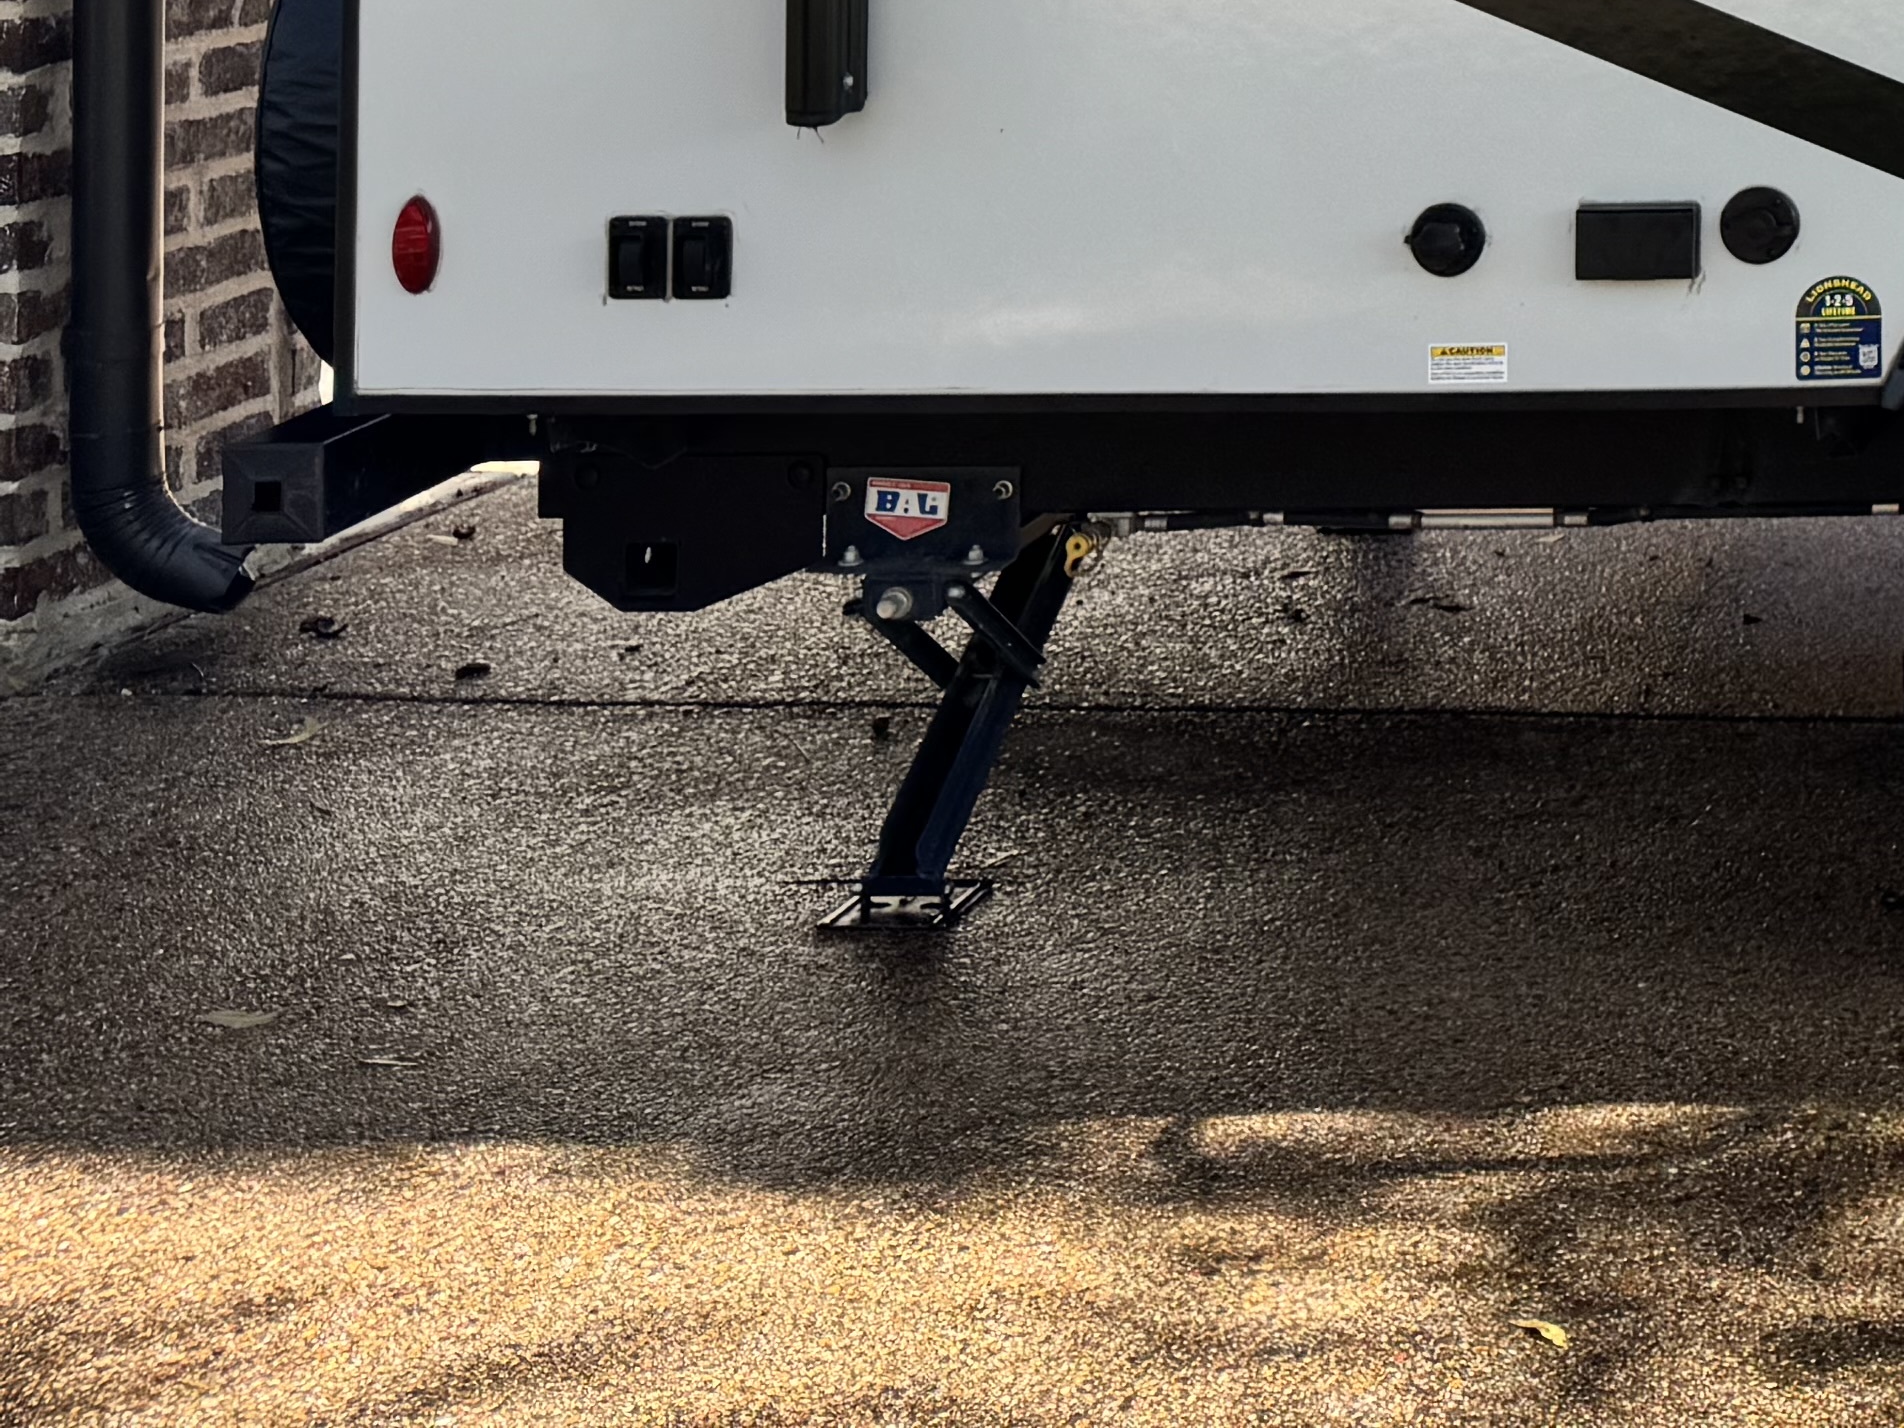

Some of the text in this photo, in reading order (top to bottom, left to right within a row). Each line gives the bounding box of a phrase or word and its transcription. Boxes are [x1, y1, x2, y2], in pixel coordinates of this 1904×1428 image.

[1806, 278, 1872, 303] LIONSHEAD
[1449, 346, 1494, 356] CAUTION
[876, 490, 939, 515] BAL
